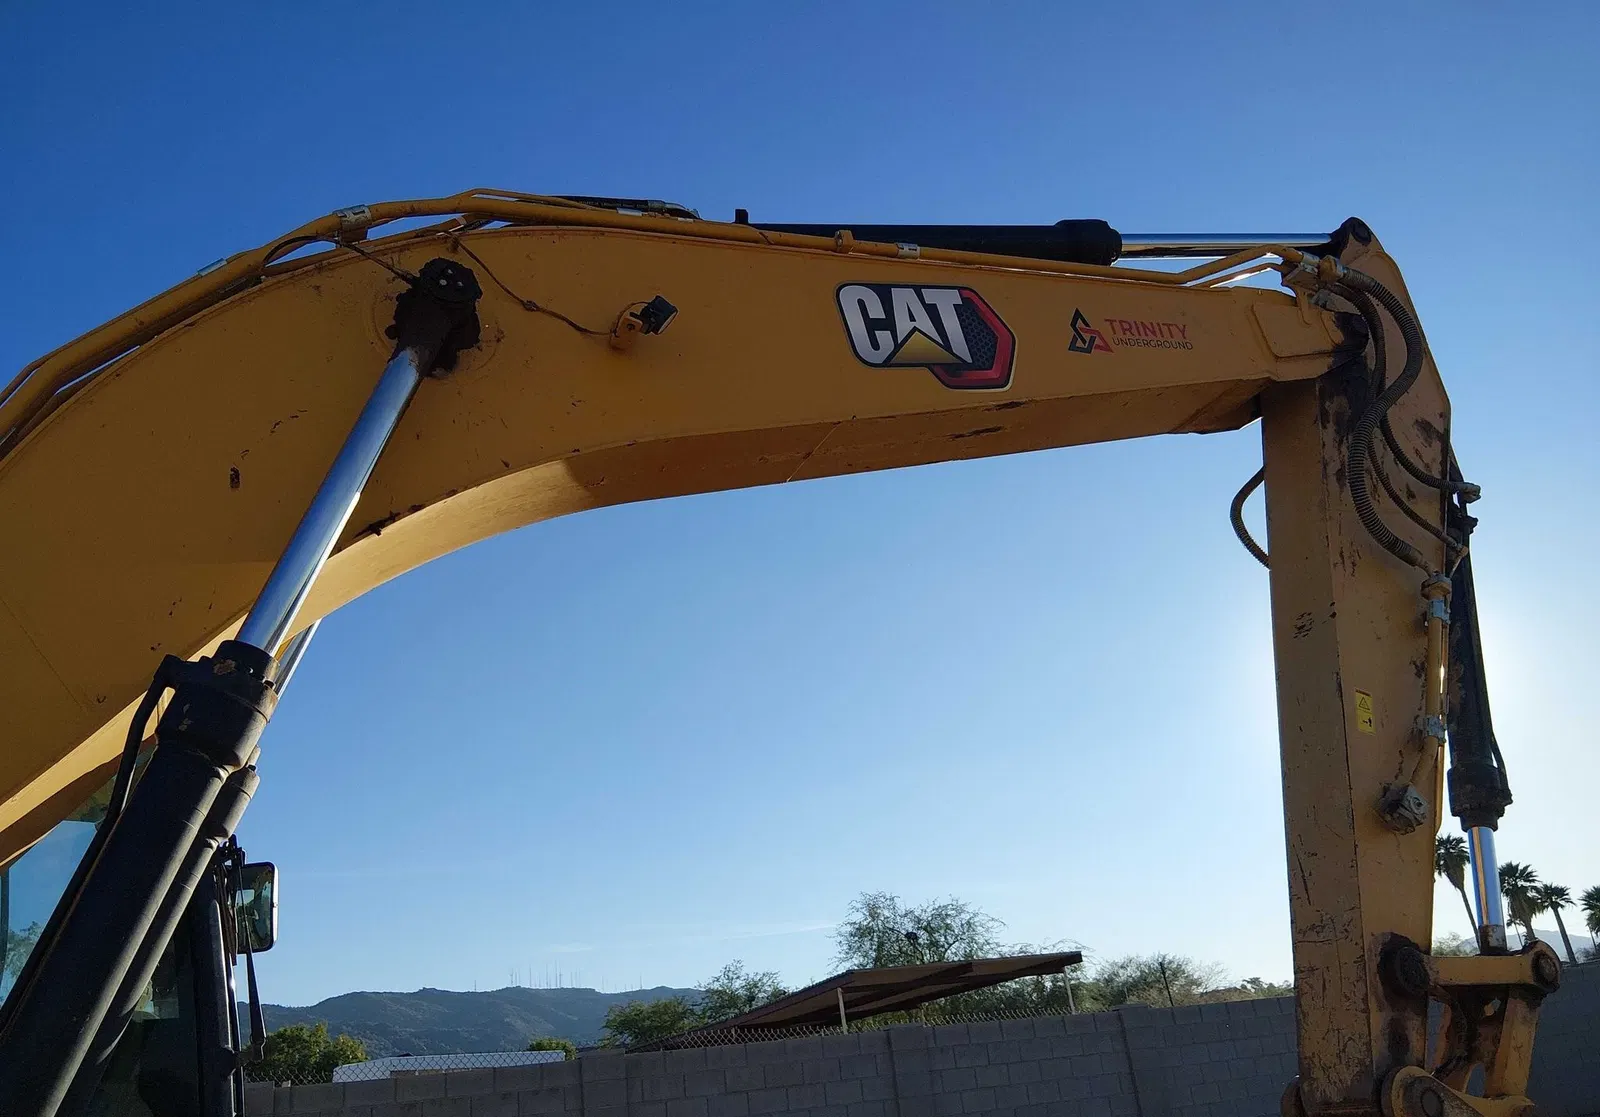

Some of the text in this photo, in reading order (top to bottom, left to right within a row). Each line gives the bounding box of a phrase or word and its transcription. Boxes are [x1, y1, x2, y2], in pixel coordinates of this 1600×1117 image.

[839, 285, 973, 364] CAT
[1104, 318, 1187, 340] TRINITY
[1112, 337, 1194, 351] UNDERGROUND
